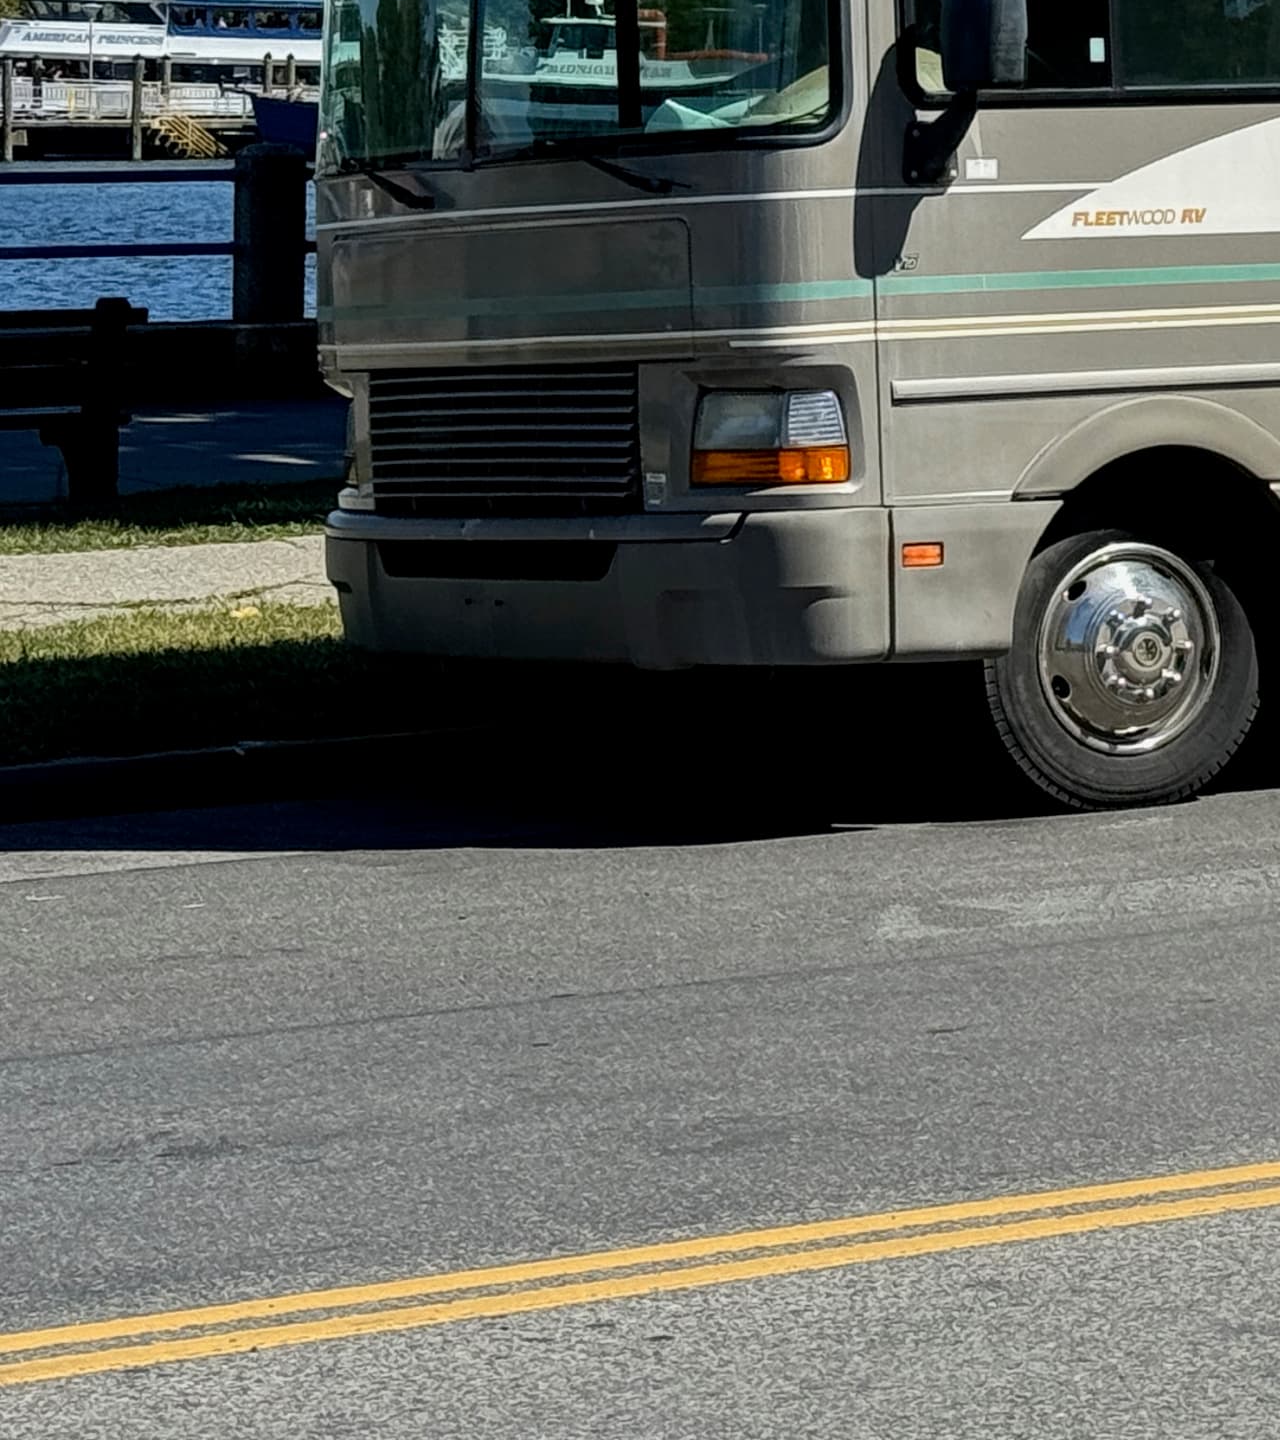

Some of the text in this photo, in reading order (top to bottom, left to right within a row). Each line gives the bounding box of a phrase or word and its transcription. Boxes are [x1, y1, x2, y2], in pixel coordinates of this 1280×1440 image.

[22, 31, 164, 46] AMERICAN PRINCESS
[546, 63, 615, 76] MIDNIGH
[1072, 208, 1207, 227] FLEETWOOD RV
